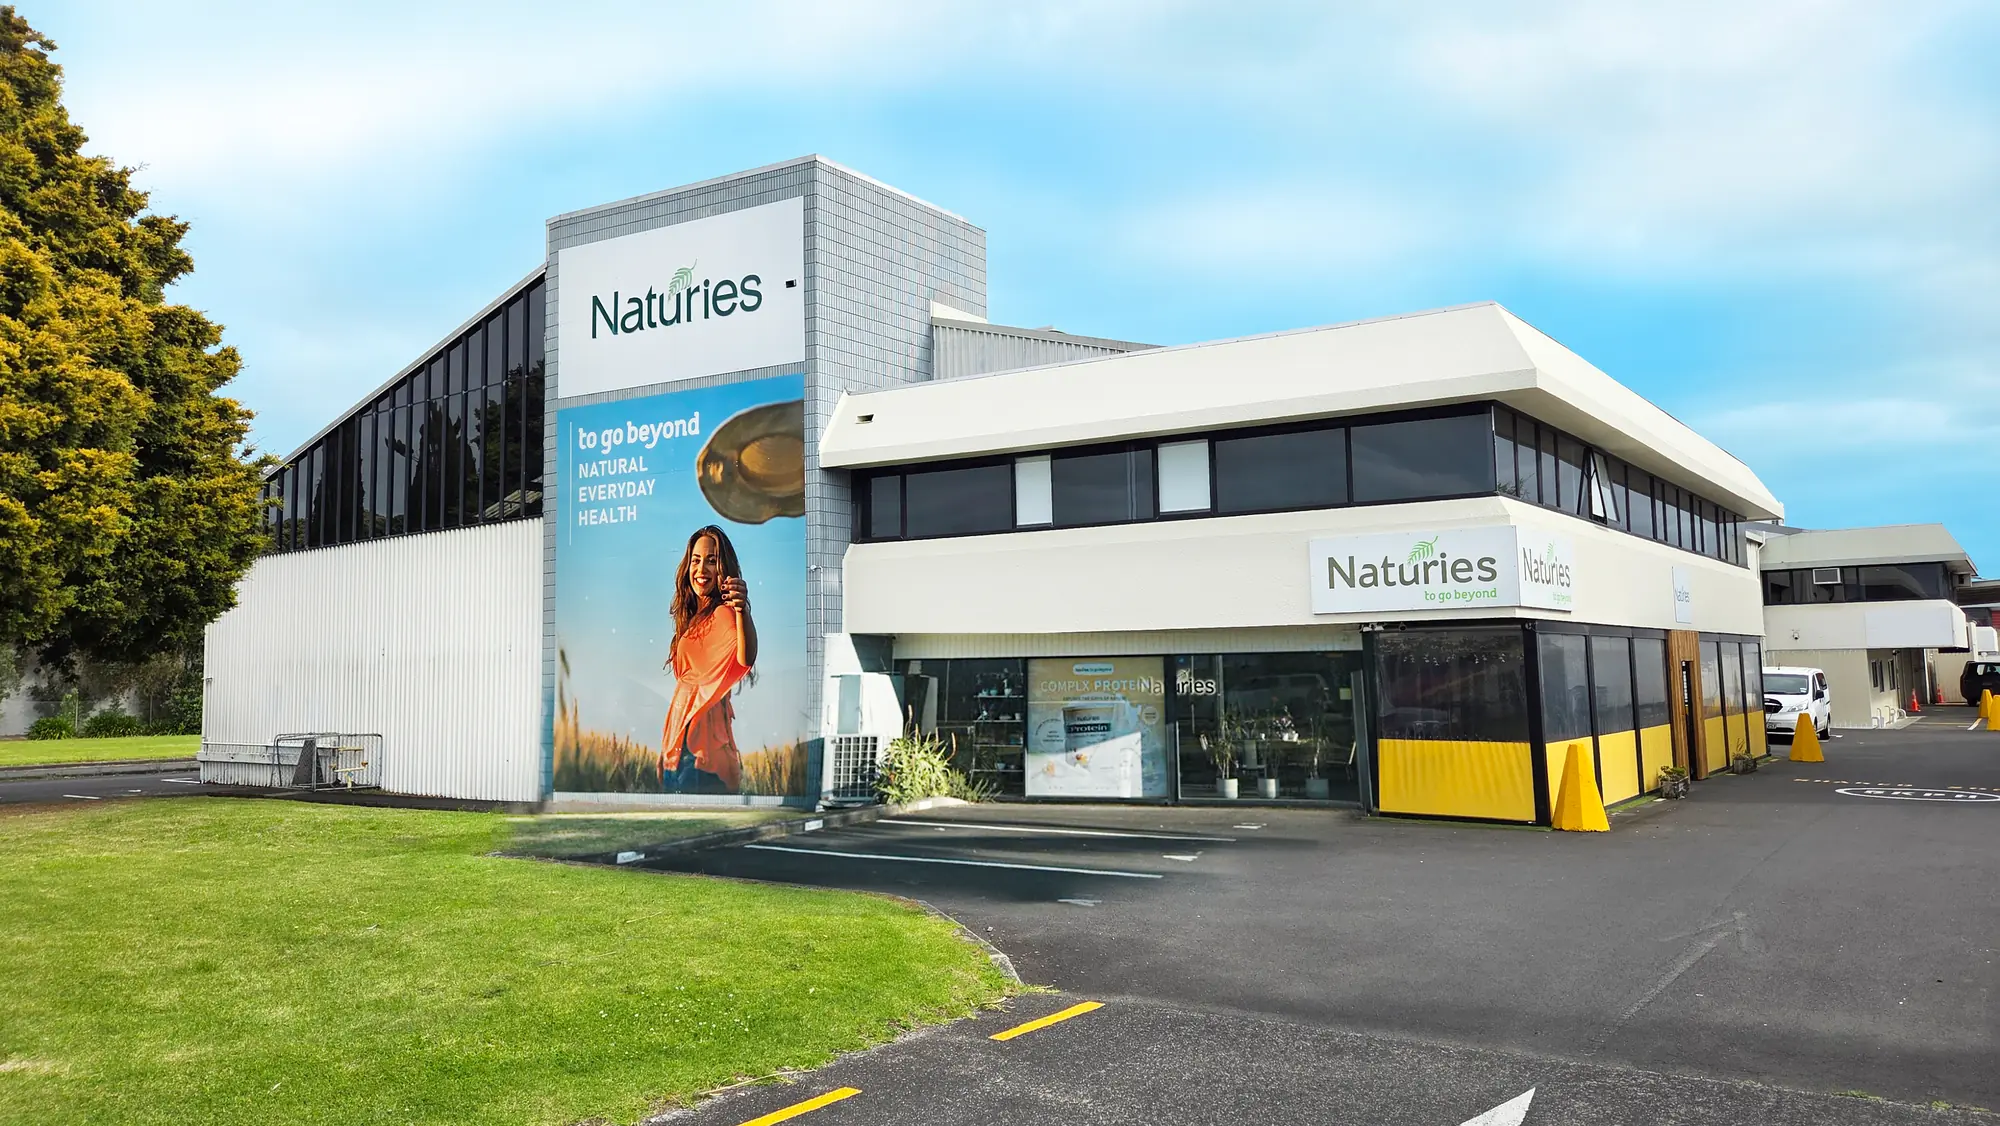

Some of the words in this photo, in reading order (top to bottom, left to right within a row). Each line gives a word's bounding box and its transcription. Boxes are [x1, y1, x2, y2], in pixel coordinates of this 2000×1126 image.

[592, 274, 762, 339] Naturies
[578, 427, 597, 450] to
[601, 427, 623, 455] go
[626, 411, 700, 449] beyond
[579, 456, 649, 479] NATURAL
[579, 479, 656, 503] EVERYDAY
[578, 505, 637, 526] HEALTH
[1327, 552, 1498, 590] Naturies
[1522, 546, 1571, 588] Naturies
[1424, 590, 1436, 601] to
[1438, 591, 1451, 603] go
[1454, 588, 1498, 603] beyond
[1040, 680, 1090, 693] COMPLX
[1138, 675, 1216, 695] Naries
[1070, 724, 1108, 733] Protein
